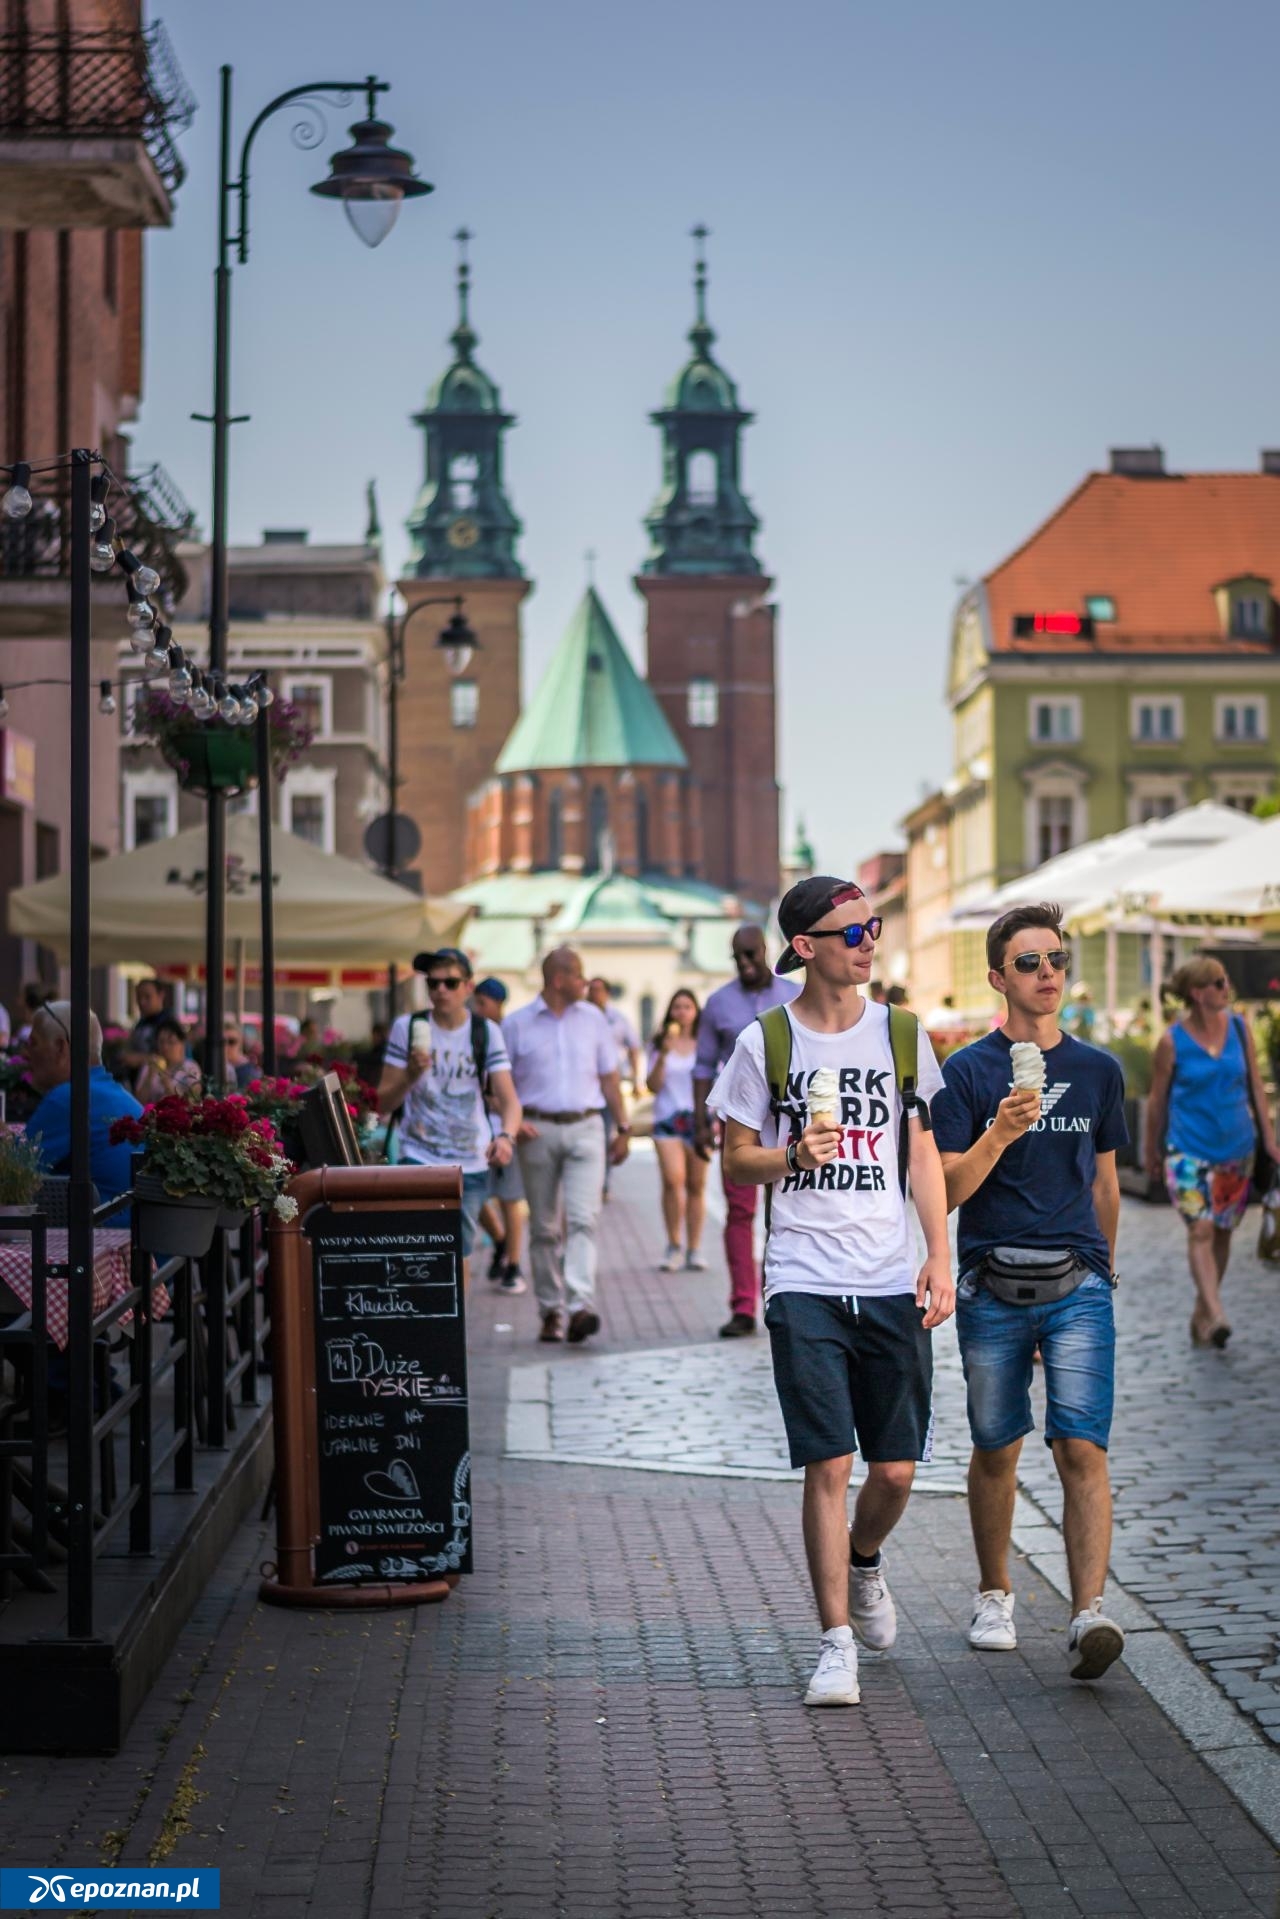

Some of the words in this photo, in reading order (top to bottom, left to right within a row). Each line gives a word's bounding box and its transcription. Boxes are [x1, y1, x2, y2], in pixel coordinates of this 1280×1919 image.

[781, 1163, 886, 1193] HARDER
[354, 1236, 367, 1246] NA
[428, 1233, 455, 1244] PIWO
[345, 1292, 420, 1315] Klaudia
[362, 1342, 423, 1377] Duże
[357, 1377, 434, 1397] TYSKIE
[404, 1408, 425, 1424] NA
